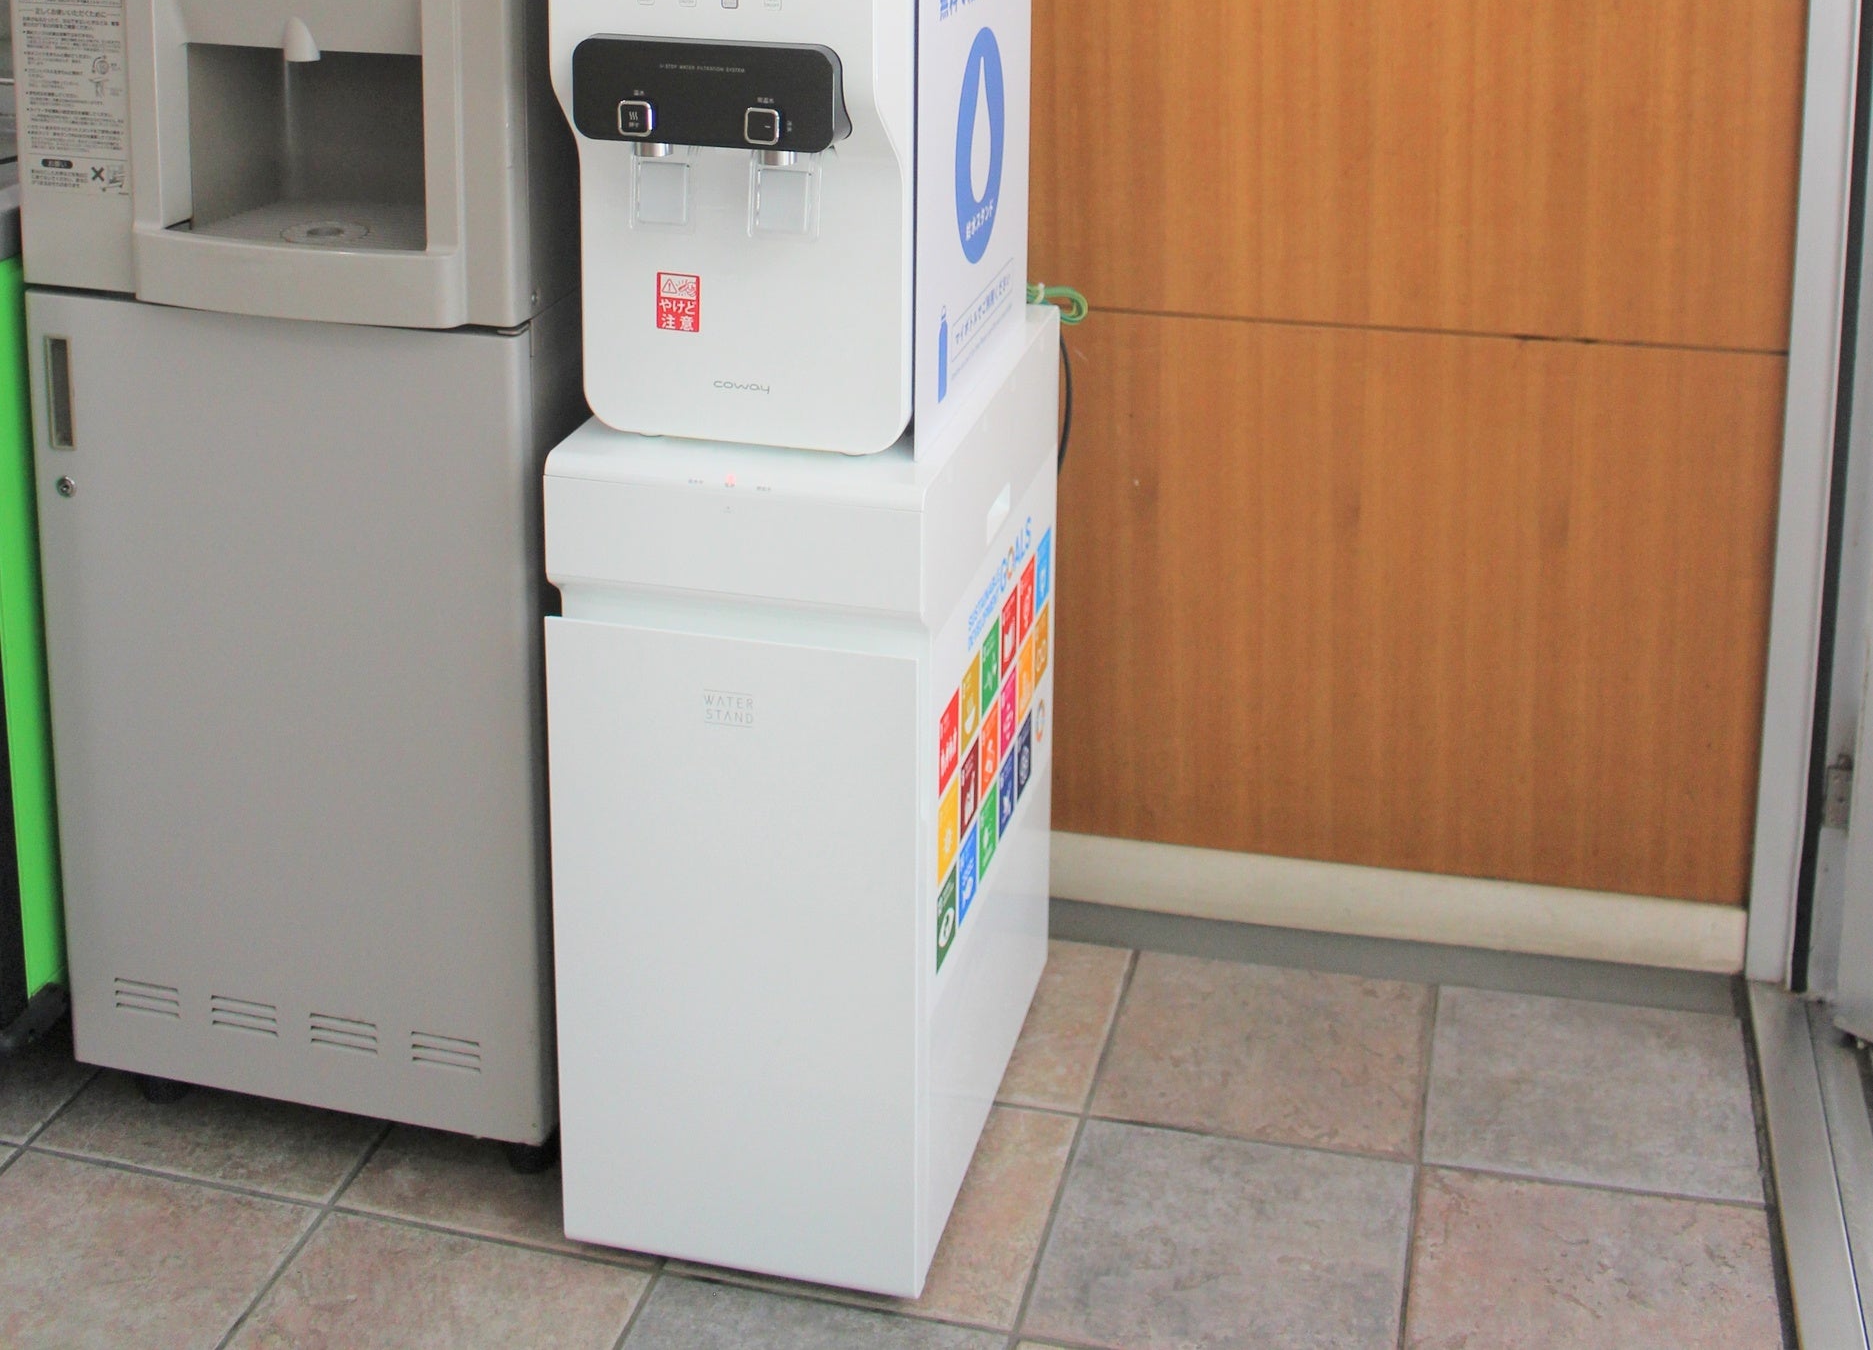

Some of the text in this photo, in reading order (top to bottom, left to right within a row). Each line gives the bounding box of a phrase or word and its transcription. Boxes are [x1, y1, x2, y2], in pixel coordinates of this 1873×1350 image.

[659, 299, 696, 315] やけど
[661, 314, 694, 330] 注意
[1000, 515, 1032, 592] GOALS
[704, 694, 753, 708] WATER
[705, 709, 753, 724] STAND
